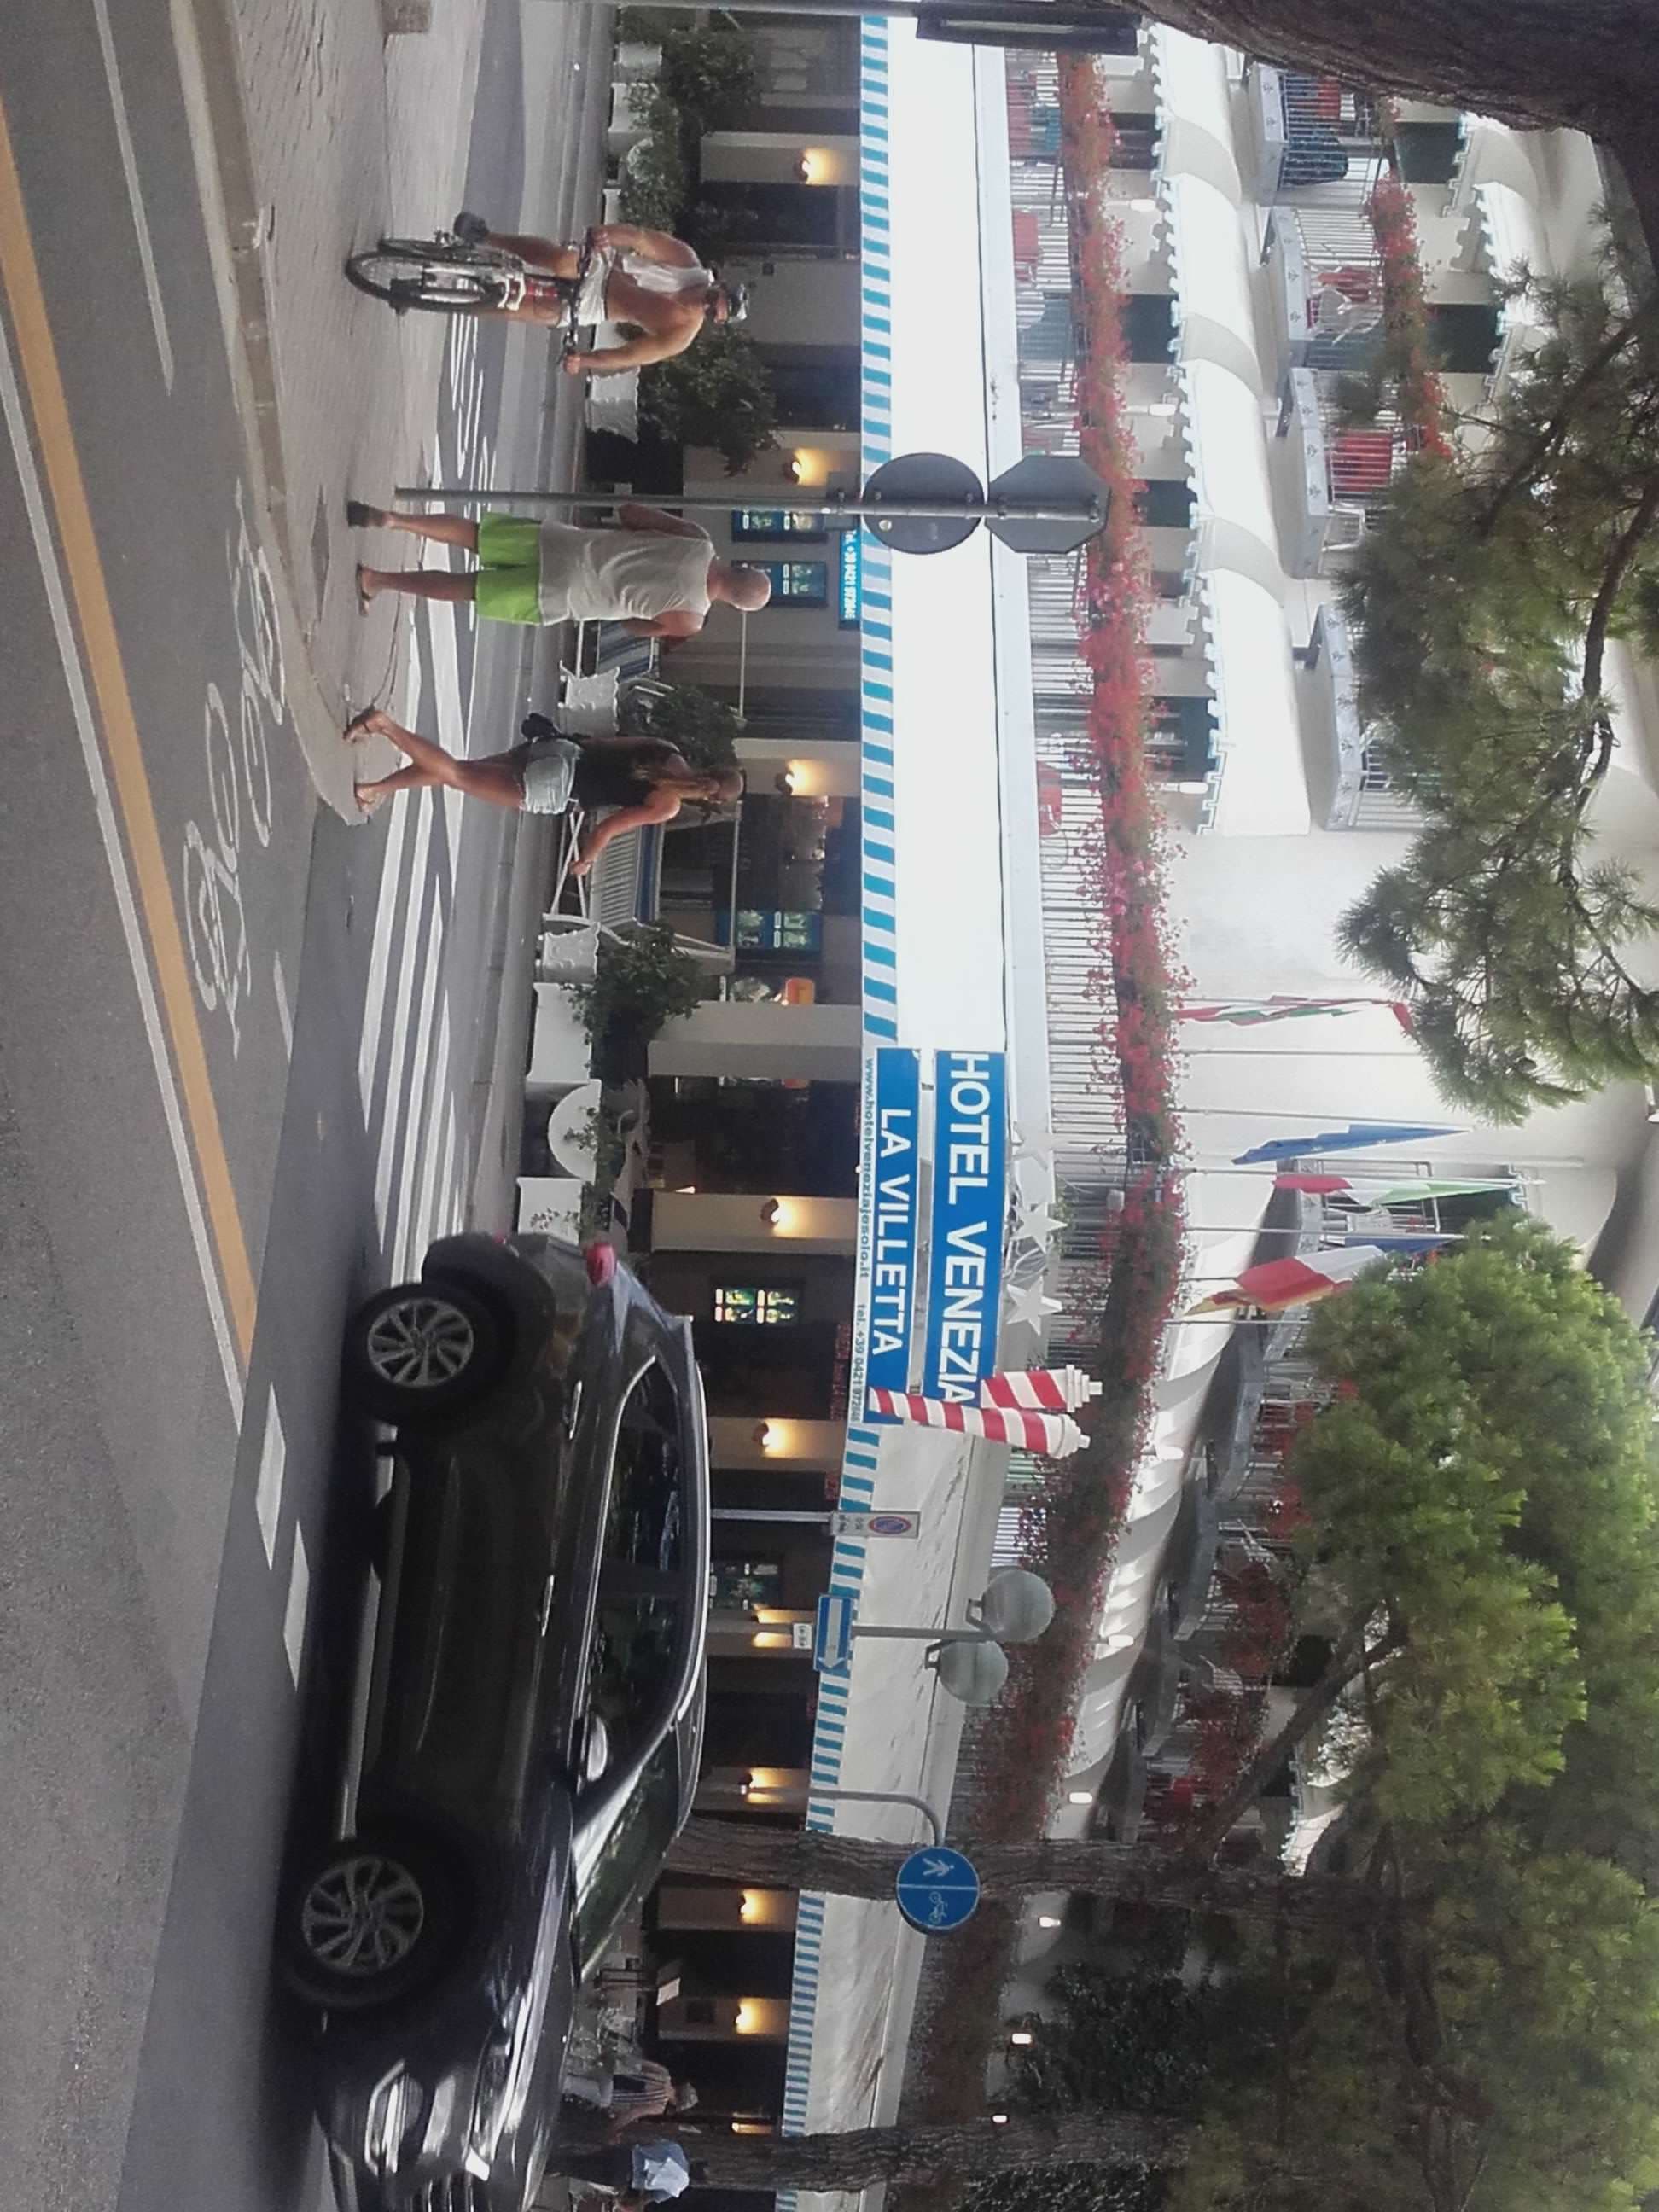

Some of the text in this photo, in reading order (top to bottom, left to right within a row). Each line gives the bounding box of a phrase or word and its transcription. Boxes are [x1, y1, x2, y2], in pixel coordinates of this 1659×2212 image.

[859, 1058, 876, 1278] www.hotelveneziajesolo.it
[937, 1053, 990, 1403] HOTEL VENEZIA
[872, 1109, 911, 1355] LA VILLETTA
[852, 1358, 864, 1385] 0421
[854, 1331, 866, 1354] +39
[855, 1304, 868, 1326] tel.
